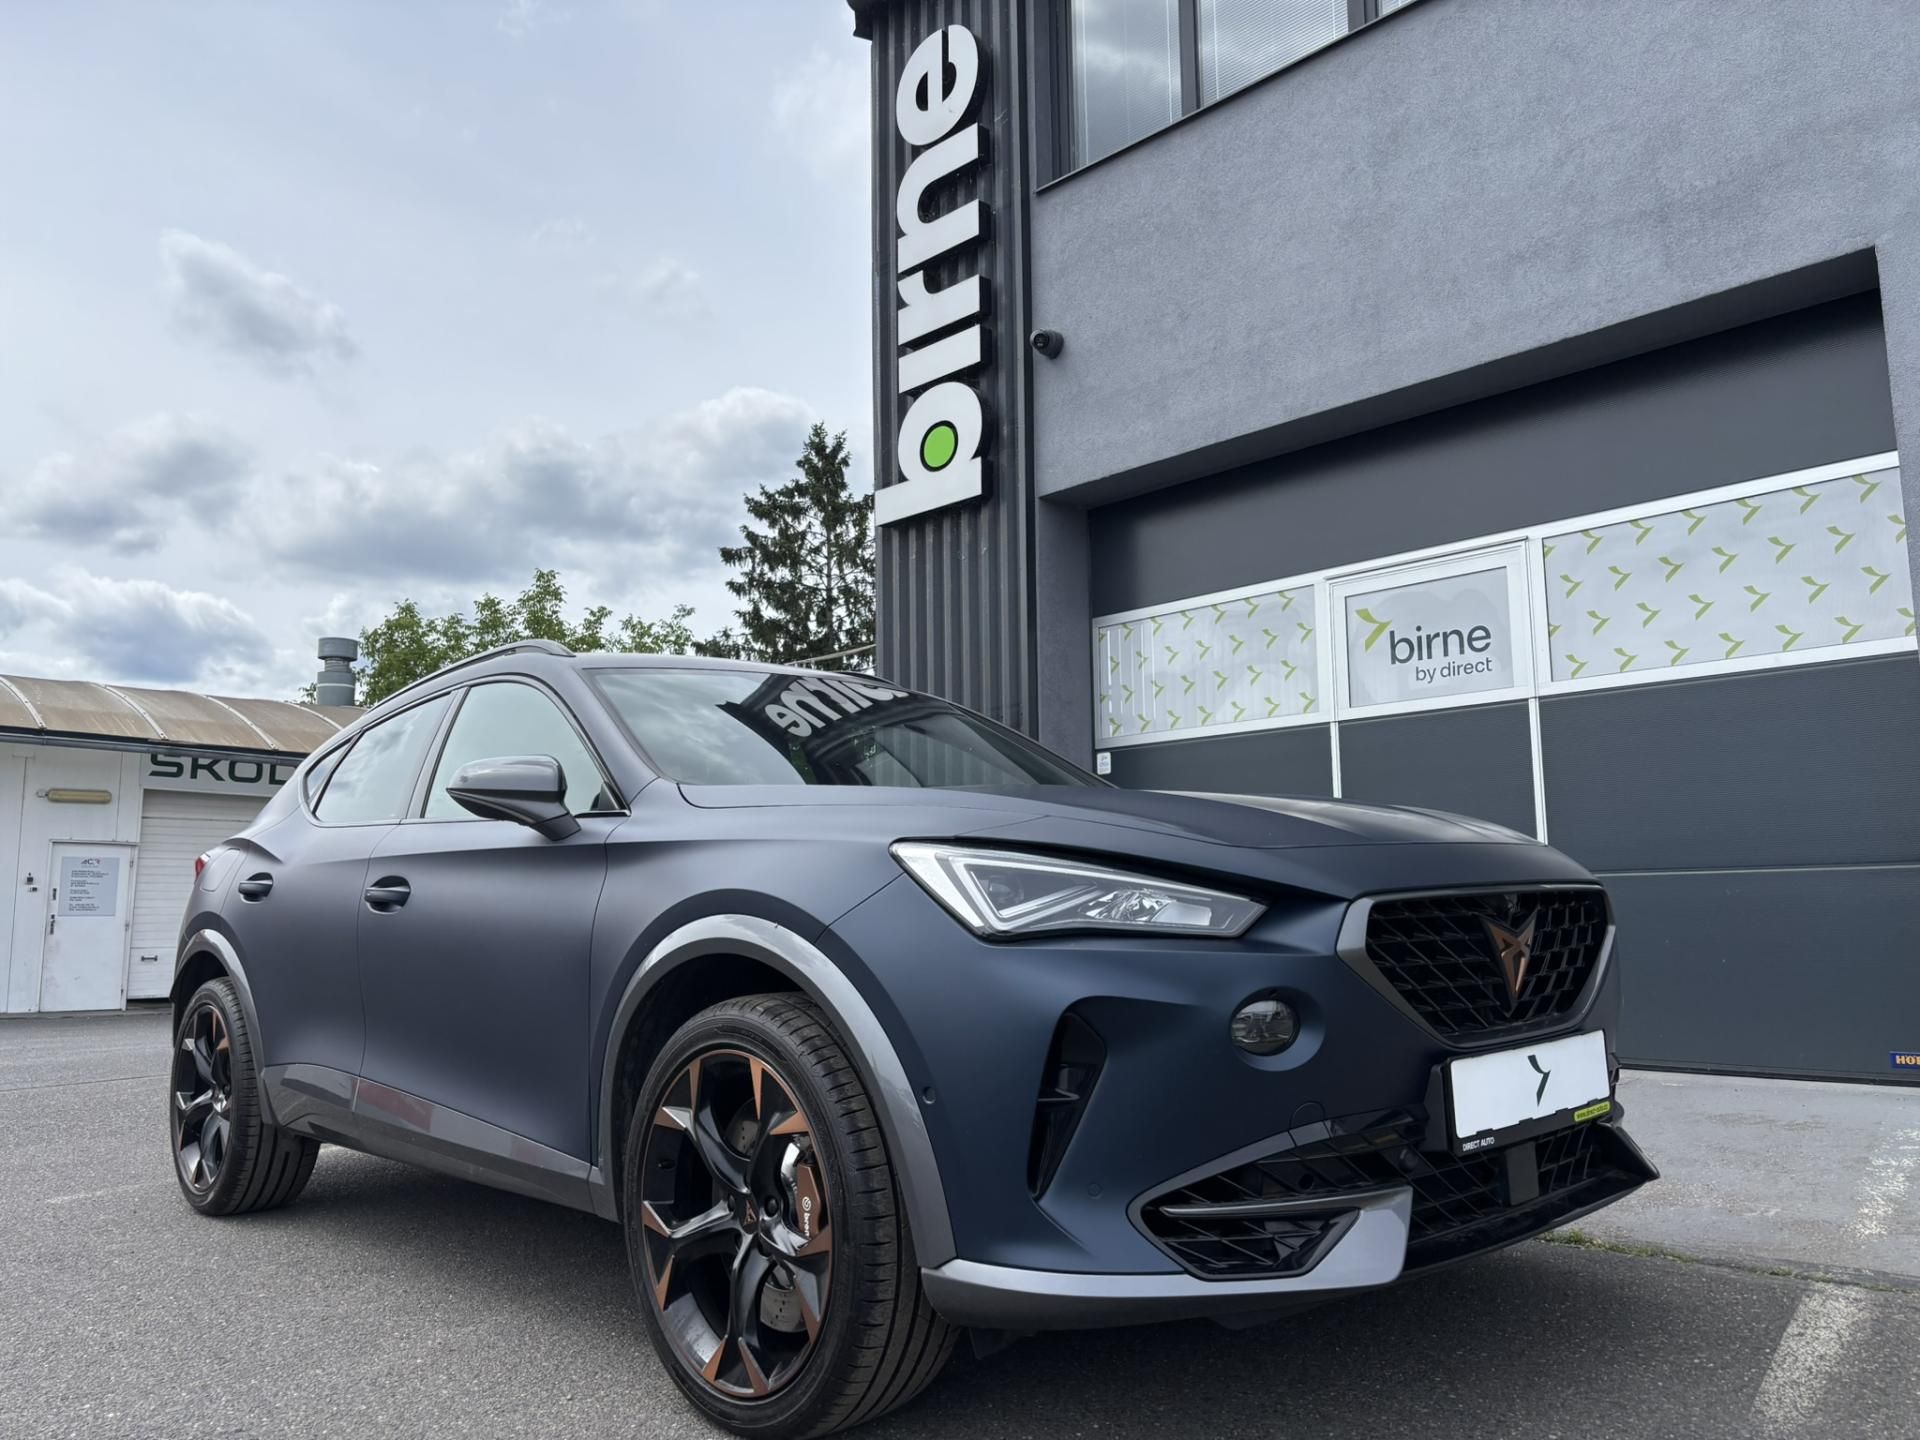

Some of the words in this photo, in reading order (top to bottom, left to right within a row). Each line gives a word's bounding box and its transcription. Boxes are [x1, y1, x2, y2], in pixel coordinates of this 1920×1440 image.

[874, 24, 982, 527] birne
[1389, 625, 1492, 665] birne
[1415, 666, 1437, 684] by
[1439, 657, 1493, 678] direct
[1462, 1139, 1480, 1152] DIRECT
[1480, 1136, 1496, 1147] AUTO
